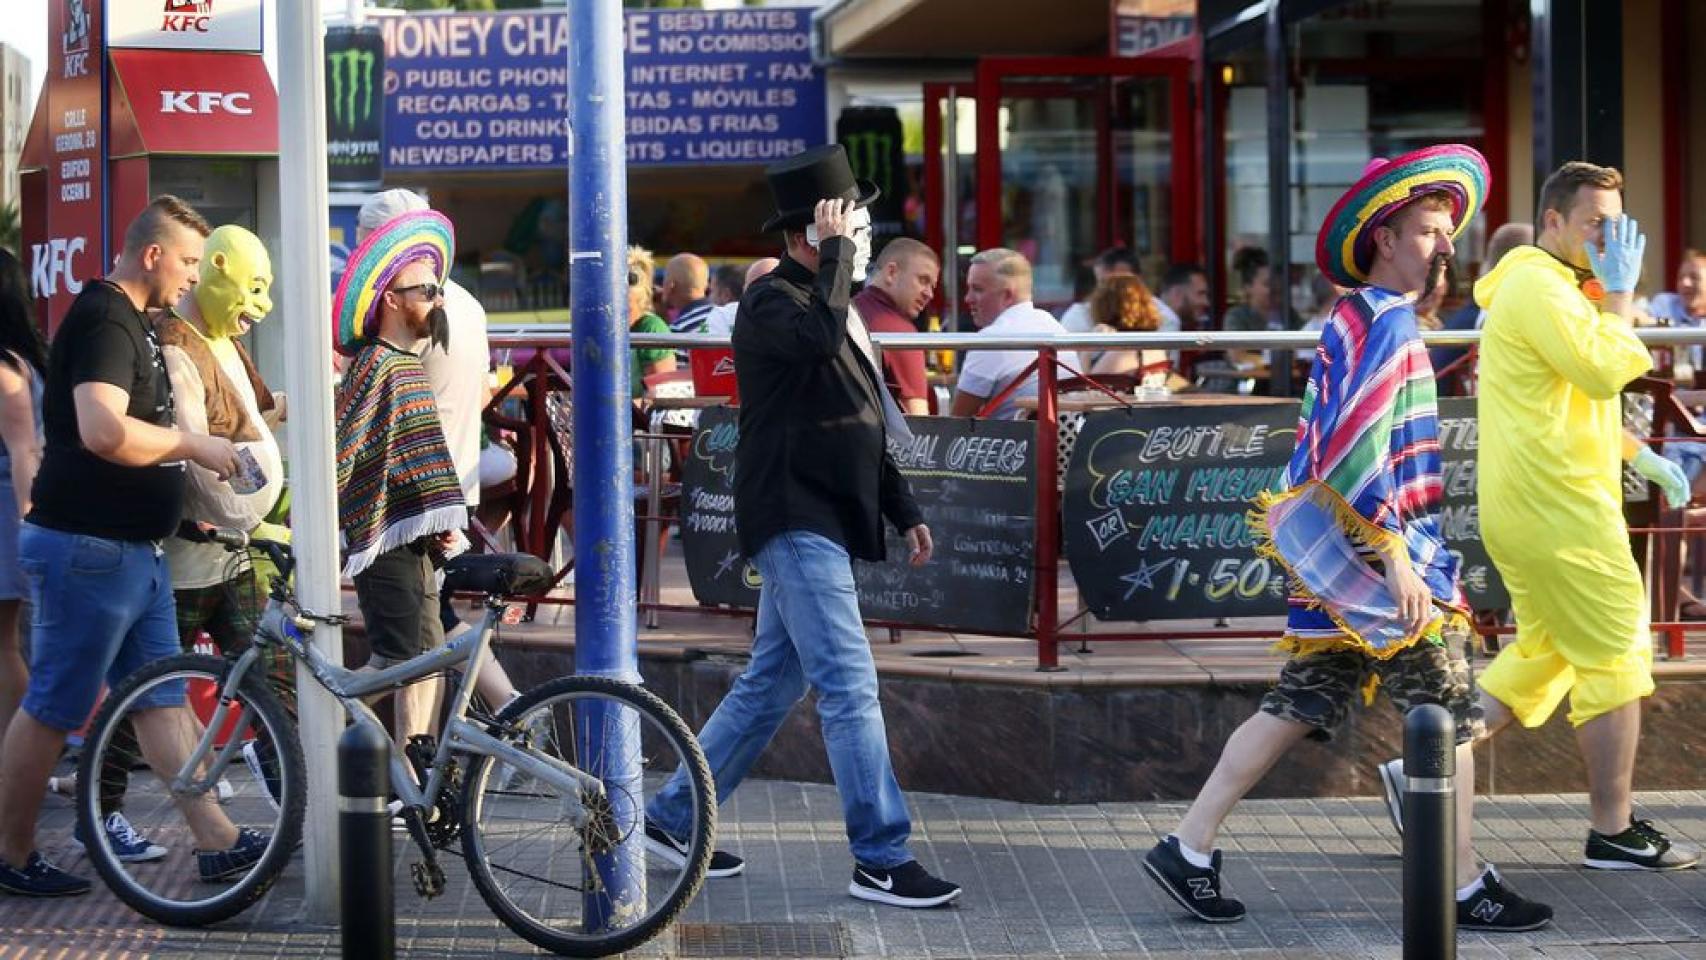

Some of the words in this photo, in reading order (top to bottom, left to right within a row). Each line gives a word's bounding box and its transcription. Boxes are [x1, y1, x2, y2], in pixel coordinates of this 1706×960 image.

[162, 16, 210, 32] KFC
[658, 12, 715, 31] BEST
[722, 10, 797, 30] RATES
[659, 34, 692, 53] NO
[698, 32, 809, 52] COMISSIO
[65, 52, 88, 78] KFC
[632, 64, 747, 83] INTERNET
[769, 63, 814, 80] FAX
[406, 70, 492, 88] PUBLIC
[499, 68, 567, 87] PHON
[160, 91, 252, 114] KFC
[397, 94, 530, 113] RECARGAS
[416, 119, 481, 138] COLD
[710, 114, 778, 132] FRIAS
[390, 146, 553, 165] NEWSPAPERS
[687, 138, 806, 160] LIQUEURS
[32, 237, 86, 298] KFC
[1139, 424, 1268, 463] BOTTLE
[946, 436, 1028, 474] OFFERS
[1106, 469, 1180, 507] SAN
[1101, 516, 1118, 538] OR
